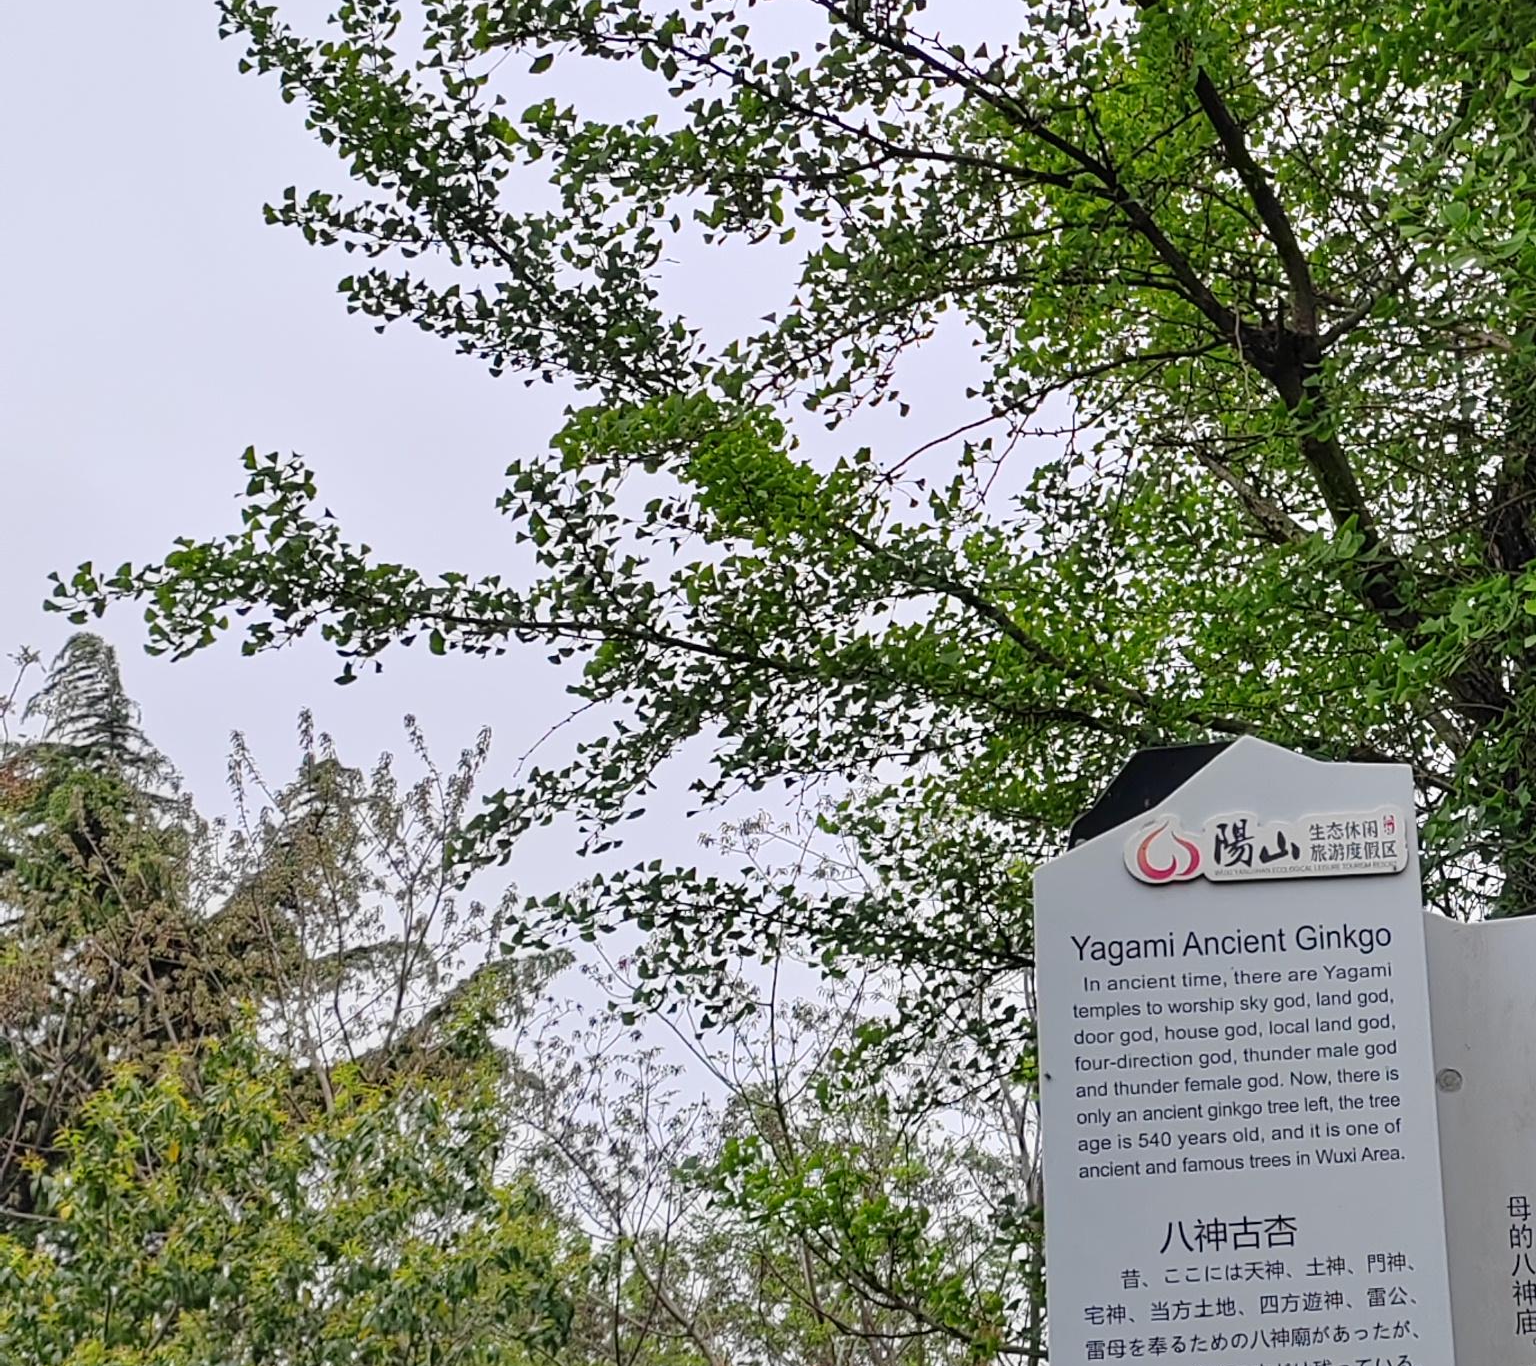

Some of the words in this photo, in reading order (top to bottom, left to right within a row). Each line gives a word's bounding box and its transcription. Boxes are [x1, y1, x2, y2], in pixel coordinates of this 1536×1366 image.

[1213, 818, 1300, 867] 陽山
[1309, 820, 1379, 841] 生态休闲
[1310, 840, 1397, 862] 旅游度假区
[1071, 932, 1174, 966] Yagami
[1182, 928, 1287, 957] Ancient
[1296, 924, 1392, 954] Ginkgo
[1084, 977, 1100, 992] In
[1107, 974, 1176, 991] ancient
[1182, 972, 1227, 988] time,
[1234, 970, 1281, 985] there
[1288, 969, 1318, 982] are
[1323, 962, 1392, 982] Yagami
[1073, 1001, 1141, 1020] temples
[1146, 1001, 1163, 1015] to
[1168, 997, 1234, 1015] worship
[1240, 996, 1268, 1013] sky
[1274, 993, 1311, 1012] god,
[1316, 990, 1351, 1006] land
[1357, 988, 1394, 1008] god,
[1074, 1030, 1114, 1045] door
[1119, 1027, 1159, 1046] god,
[1164, 1026, 1219, 1040] house
[1224, 1022, 1263, 1041] god,
[1269, 1018, 1309, 1035] local
[1315, 1016, 1352, 1032] land
[1358, 1014, 1396, 1033] god,
[1074, 1053, 1193, 1072] four-direction
[1199, 1049, 1237, 1069] god,
[1243, 1046, 1312, 1063] thunder
[1317, 1042, 1359, 1058] male
[1365, 1040, 1397, 1059] god
[1076, 1081, 1108, 1098] and
[1114, 1079, 1180, 1096] thunder
[1184, 1075, 1242, 1092] female
[1247, 1073, 1284, 1092] god.
[1290, 1071, 1332, 1086] Now,
[1337, 1068, 1380, 1083] there
[1385, 1066, 1399, 1081] is
[1077, 1109, 1111, 1127] only
[1116, 1110, 1137, 1122] an
[1143, 1104, 1203, 1121] ancient
[1207, 1101, 1262, 1121] ginkgo
[1268, 1100, 1299, 1114] tree
[1304, 1096, 1334, 1113] left,
[1338, 1095, 1364, 1110] the
[1369, 1094, 1400, 1108] tree
[1078, 1138, 1112, 1155] age
[1117, 1135, 1132, 1150] is
[1138, 1131, 1172, 1149] 540
[1177, 1131, 1227, 1150] years
[1233, 1127, 1265, 1143] old,
[1271, 1125, 1304, 1141] and
[1310, 1124, 1321, 1138] it
[1326, 1123, 1341, 1137] is
[1346, 1123, 1379, 1136] one
[1384, 1118, 1402, 1134] of
[1079, 1161, 1141, 1179] ancient
[1145, 1158, 1177, 1175] and
[1182, 1156, 1244, 1173] famous
[1249, 1154, 1291, 1168] trees
[1296, 1151, 1310, 1166] in
[1315, 1147, 1357, 1165] Wuxi
[1361, 1147, 1405, 1162] Area.
[1159, 1214, 1298, 1254] 八神古杏
